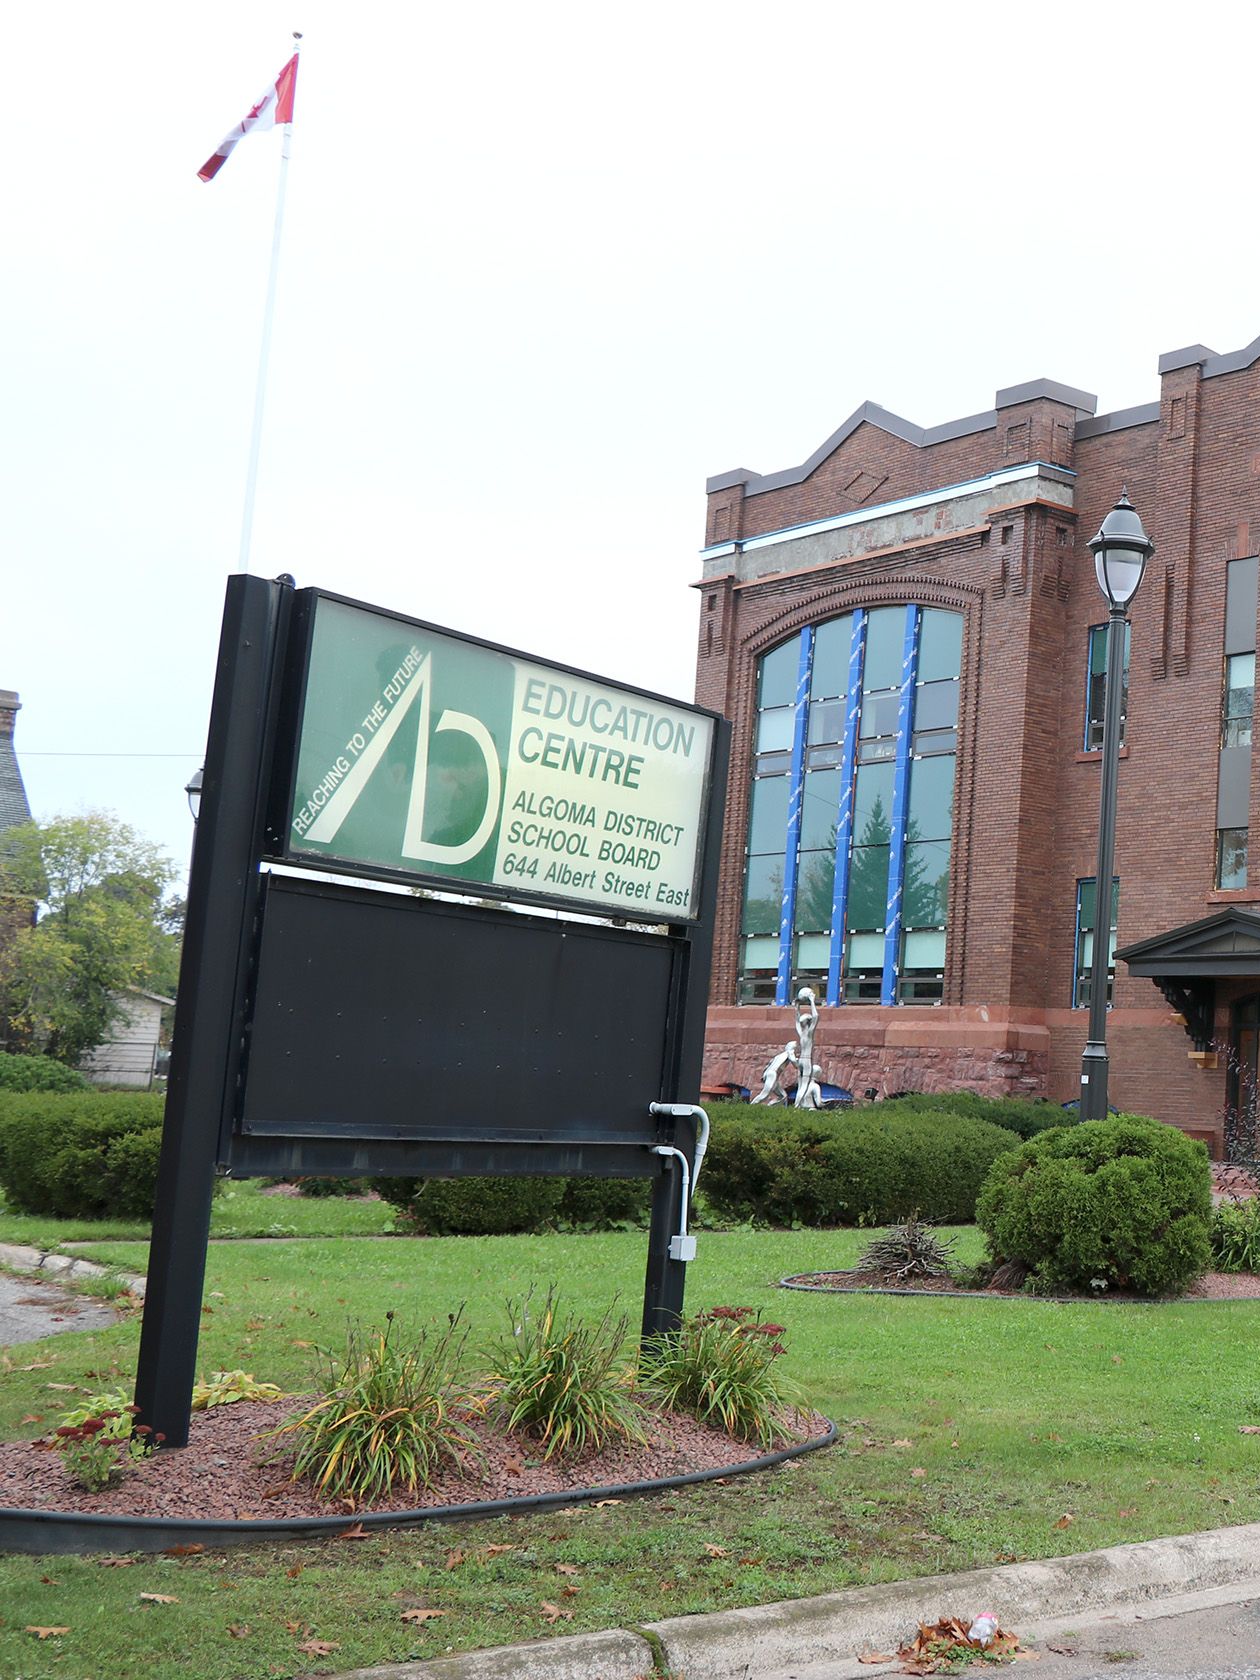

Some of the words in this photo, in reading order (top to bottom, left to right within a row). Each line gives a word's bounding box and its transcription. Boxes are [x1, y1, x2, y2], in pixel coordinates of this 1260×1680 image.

[292, 756, 351, 835] REACHING
[346, 733, 366, 756] TO
[362, 700, 388, 733] THE
[383, 645, 424, 704] FUTURE
[521, 678, 695, 757] EDUCATION
[518, 726, 645, 789] CENTRE
[507, 820, 590, 857] SCHOOL
[598, 840, 661, 871] BOARD
[512, 790, 596, 828] ALGOMA
[603, 810, 684, 846] DISTRICT
[503, 853, 539, 879] 644
[544, 861, 596, 889] Albert
[602, 871, 651, 899] Street
[656, 882, 690, 907] East
